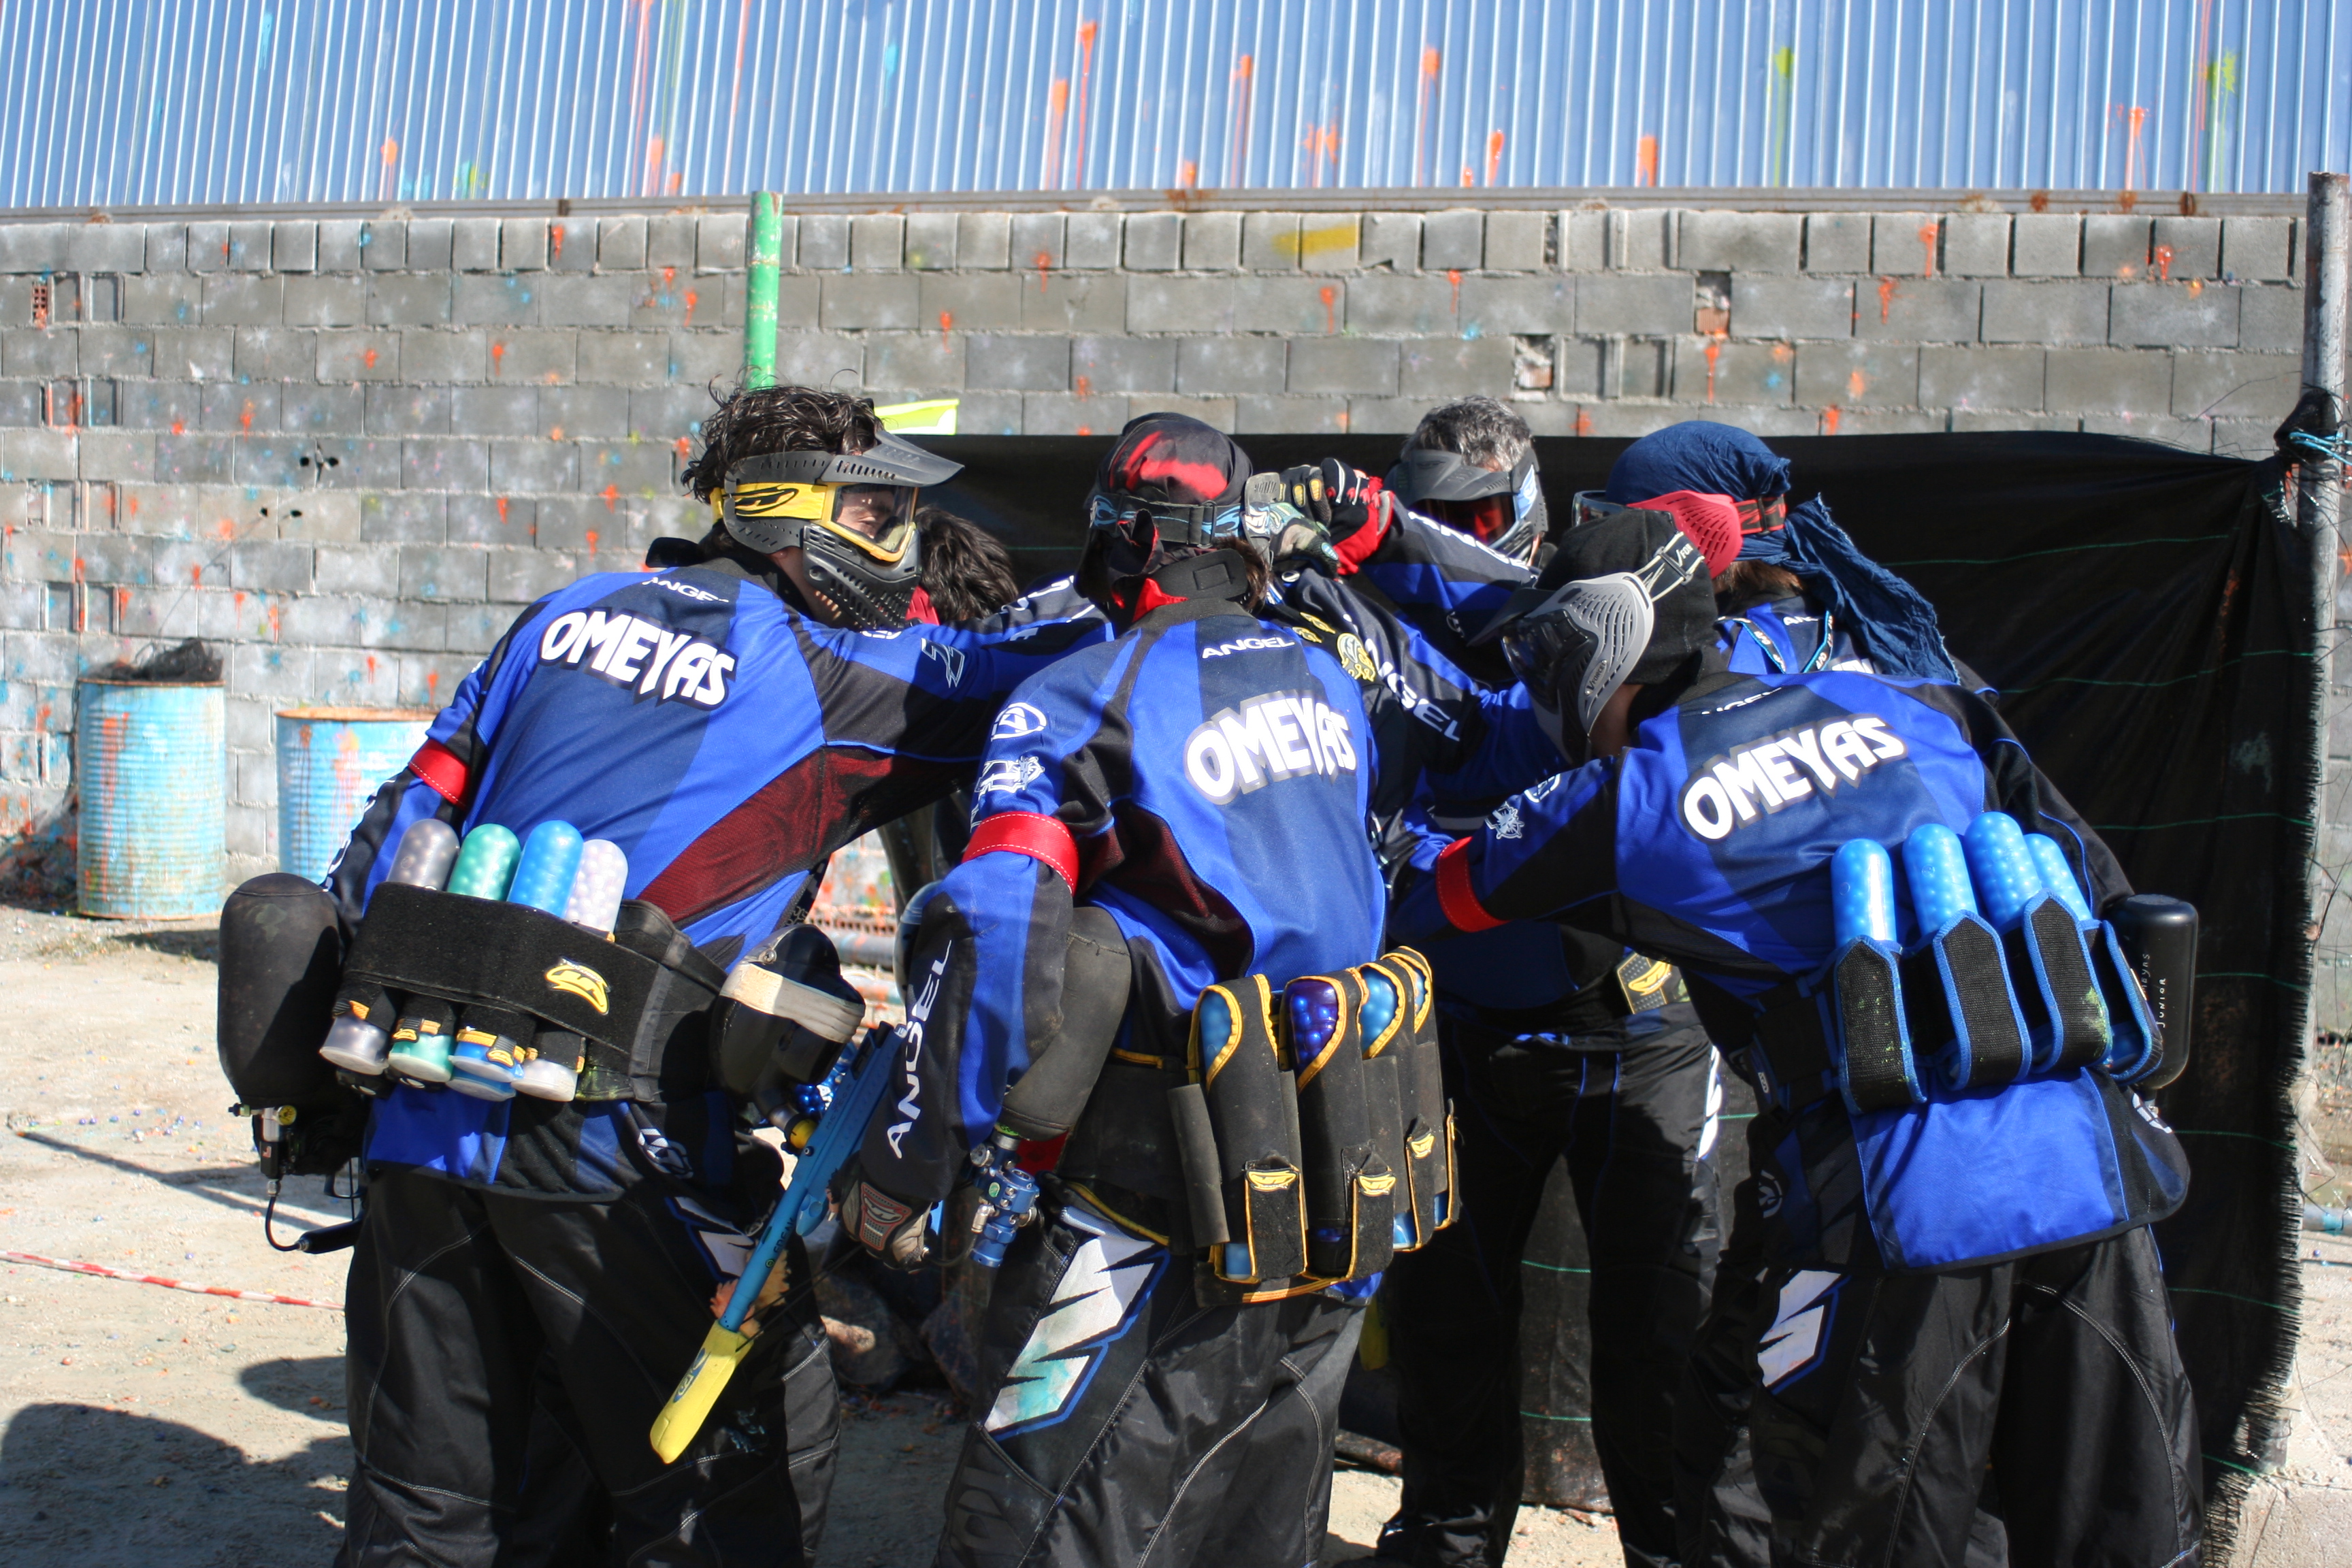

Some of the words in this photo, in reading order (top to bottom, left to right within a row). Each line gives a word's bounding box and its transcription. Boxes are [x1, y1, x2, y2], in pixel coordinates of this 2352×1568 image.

[540, 610, 736, 707] OMEYAS
[1202, 636, 1295, 659] ANGEL
[1187, 693, 1358, 803] OMEYAS
[1682, 715, 1906, 840] OMEYAS
